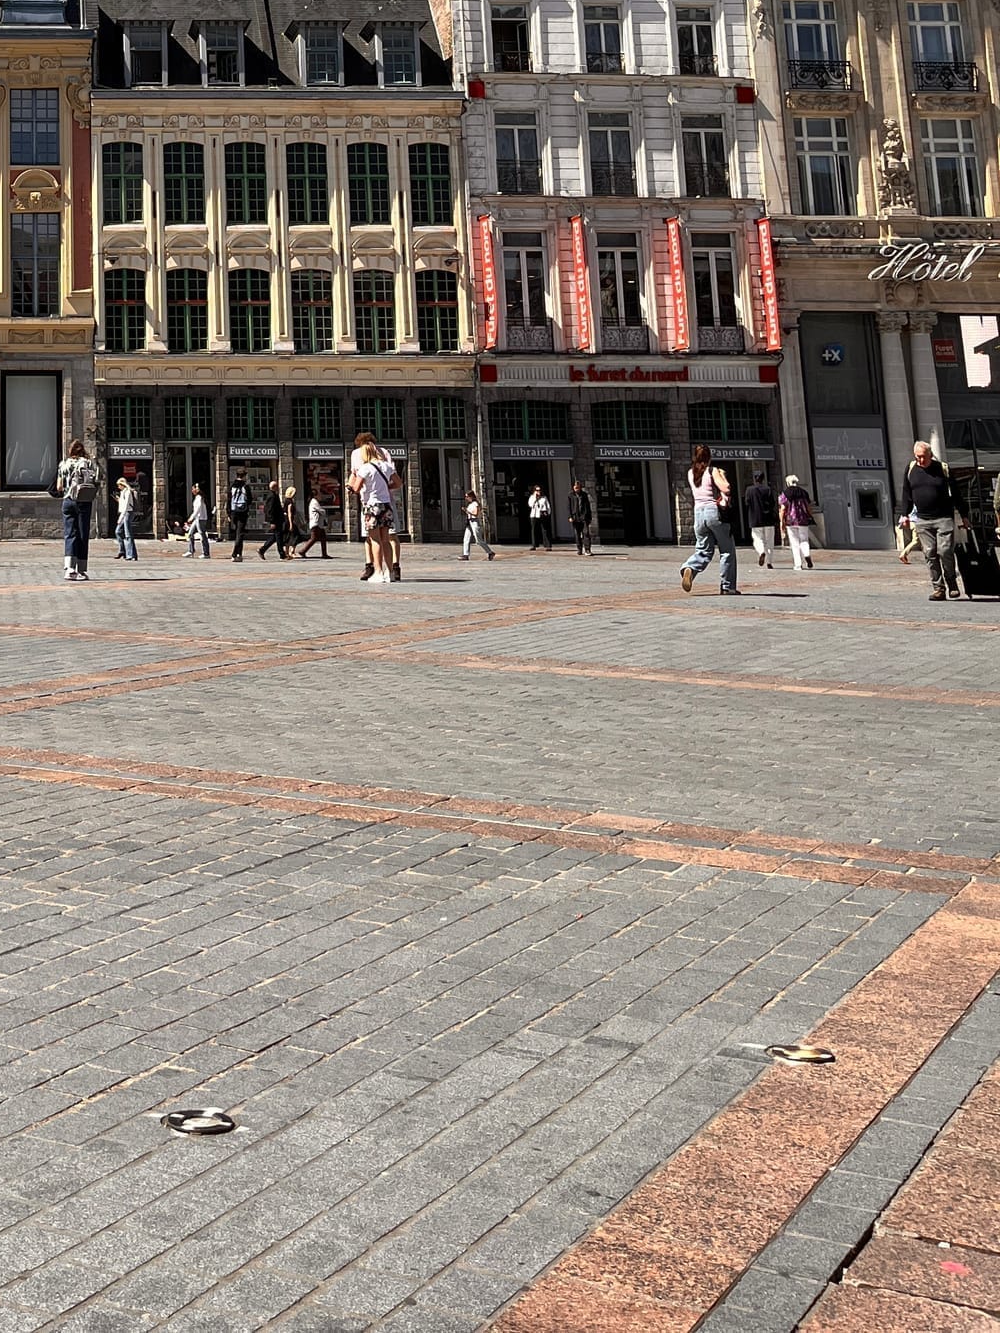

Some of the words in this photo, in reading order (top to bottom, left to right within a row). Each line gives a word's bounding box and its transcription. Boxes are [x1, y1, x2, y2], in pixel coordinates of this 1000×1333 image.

[482, 221, 491, 263] nord
[572, 222, 582, 264] nord
[668, 223, 680, 265] nord
[758, 223, 770, 266] nord
[867, 242, 984, 282] Hôtel
[484, 267, 494, 291] du
[576, 268, 585, 292] du
[674, 269, 682, 294] du
[764, 270, 774, 294] du
[579, 295, 588, 344] Furet
[676, 298, 685, 345] Furet
[766, 297, 778, 346] Furet
[569, 364, 585, 382] le
[586, 364, 628, 382] furet
[113, 446, 147, 456] Presse
[229, 446, 277, 456] Furet.com
[510, 447, 555, 456] Librairie
[600, 448, 623, 456] Livres
[624, 448, 665, 456] d'occasion
[710, 448, 759, 458] Papeterie
[856, 459, 884, 467] LILLE
